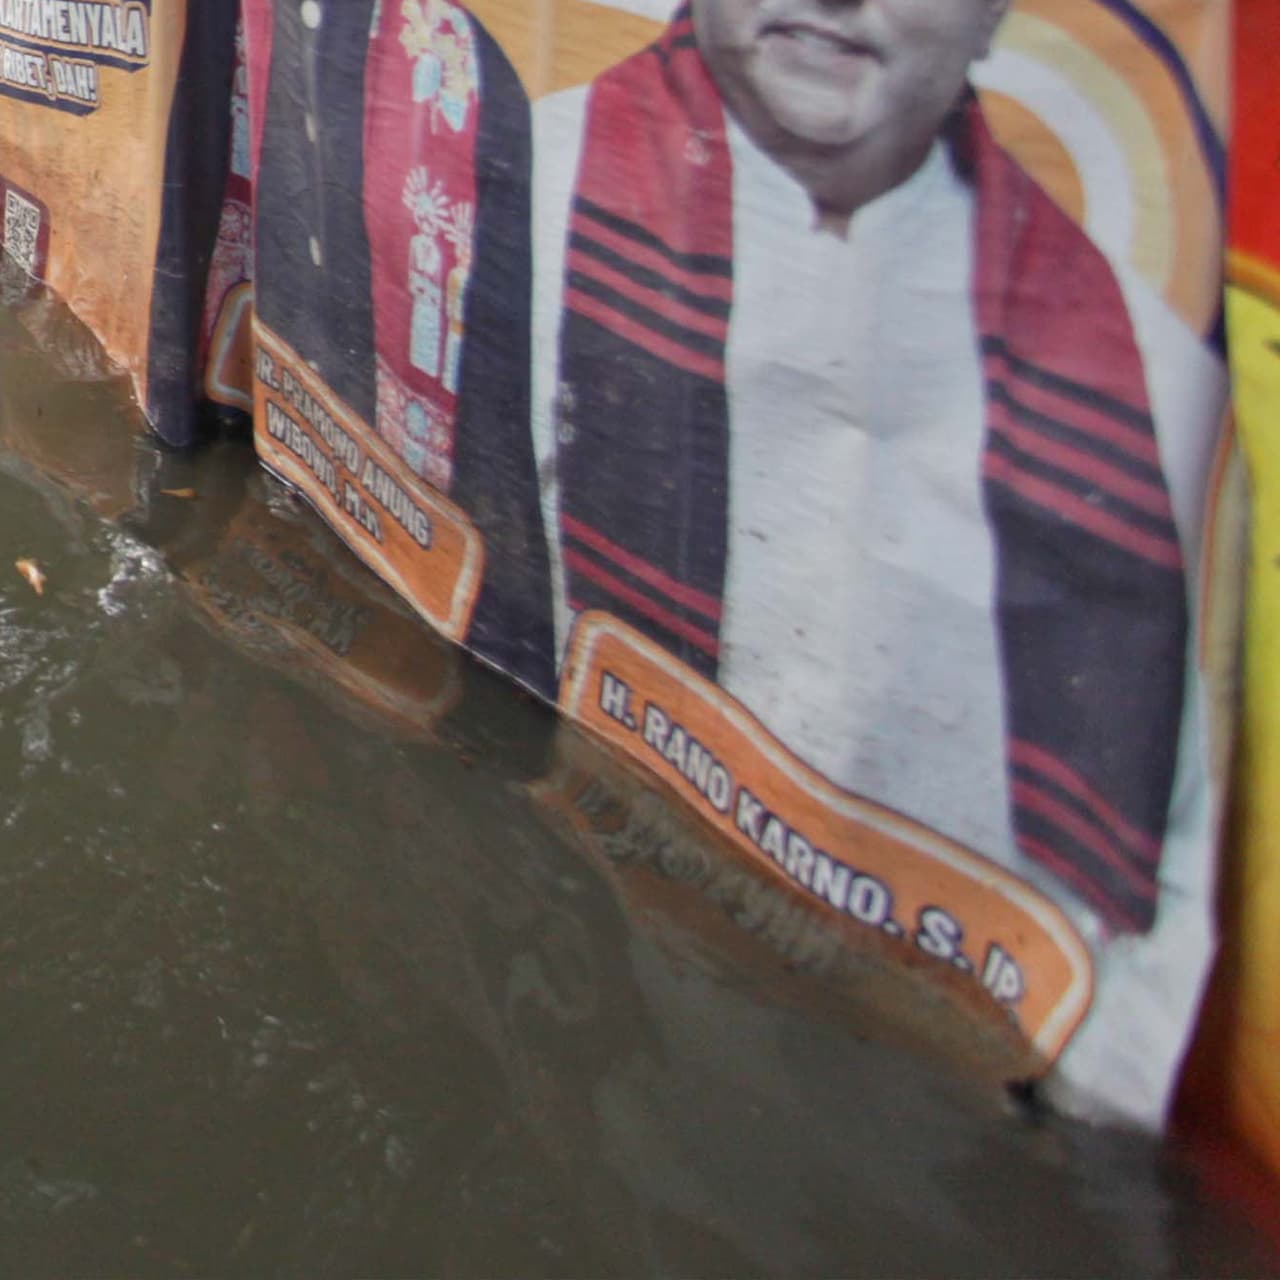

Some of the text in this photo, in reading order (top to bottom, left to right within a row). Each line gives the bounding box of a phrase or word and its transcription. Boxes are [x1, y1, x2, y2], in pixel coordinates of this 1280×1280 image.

[52, 60, 97, 102] DAH!
[267, 400, 341, 503] WIBOWO,
[362, 458, 431, 548] ANUNG
[600, 673, 637, 729] H.
[645, 704, 731, 811] RANO
[982, 945, 1021, 999] IP
